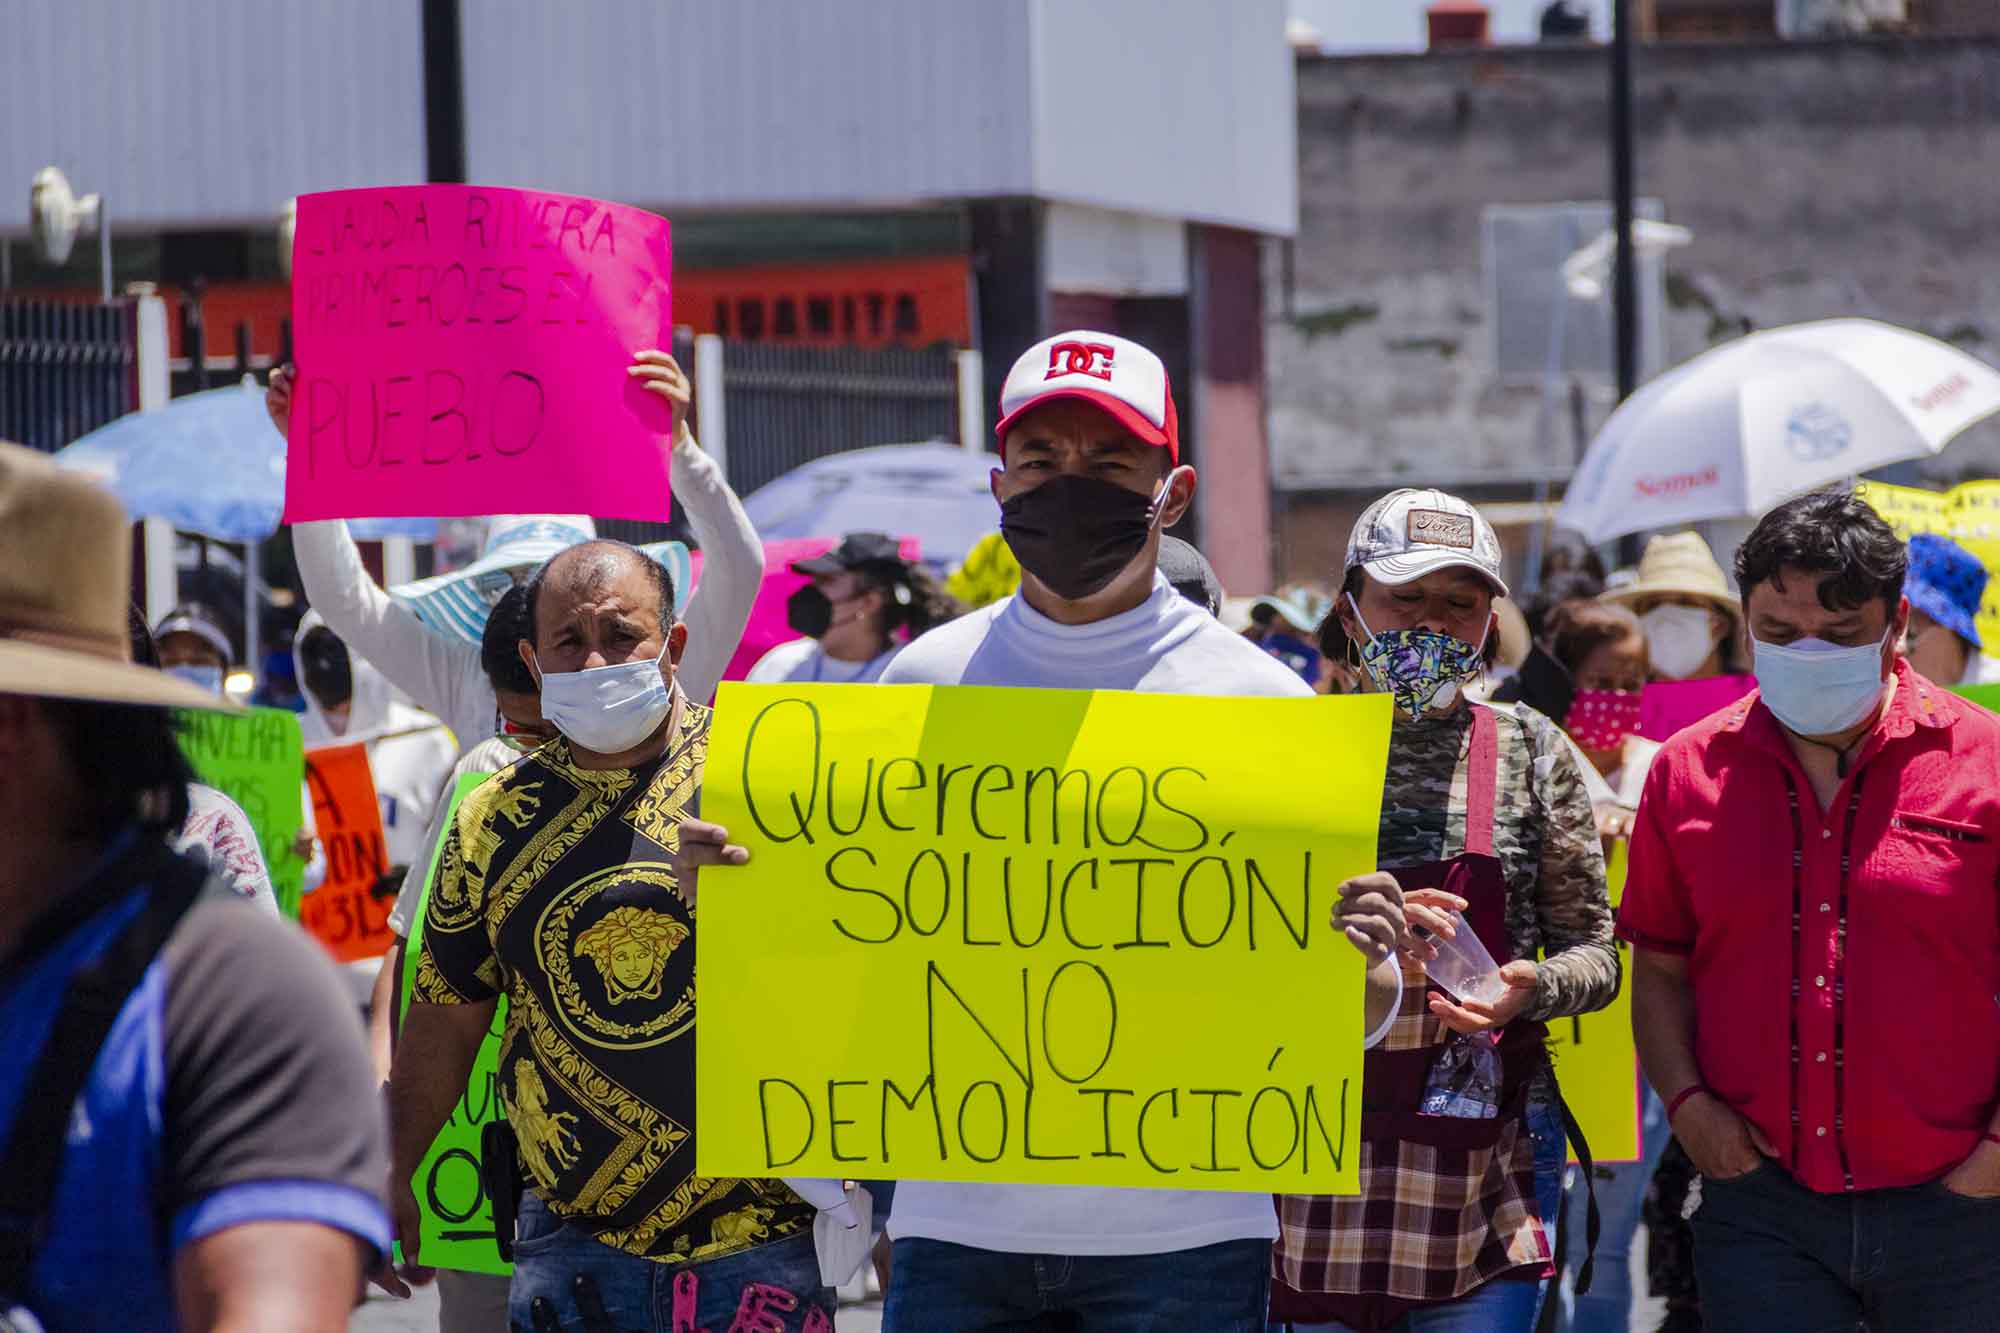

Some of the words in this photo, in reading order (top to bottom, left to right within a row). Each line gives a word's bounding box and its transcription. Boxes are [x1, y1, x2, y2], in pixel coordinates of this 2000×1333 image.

[464, 195, 617, 257] RIVERA
[306, 368, 546, 481] PUEBLO
[1416, 513, 1468, 536] Ford
[741, 697, 1210, 853] Queremos
[824, 831, 1312, 951] SOLUCIÓN
[926, 960, 1118, 1090] NO
[758, 1046, 1350, 1174] DEMOLICIÓN
